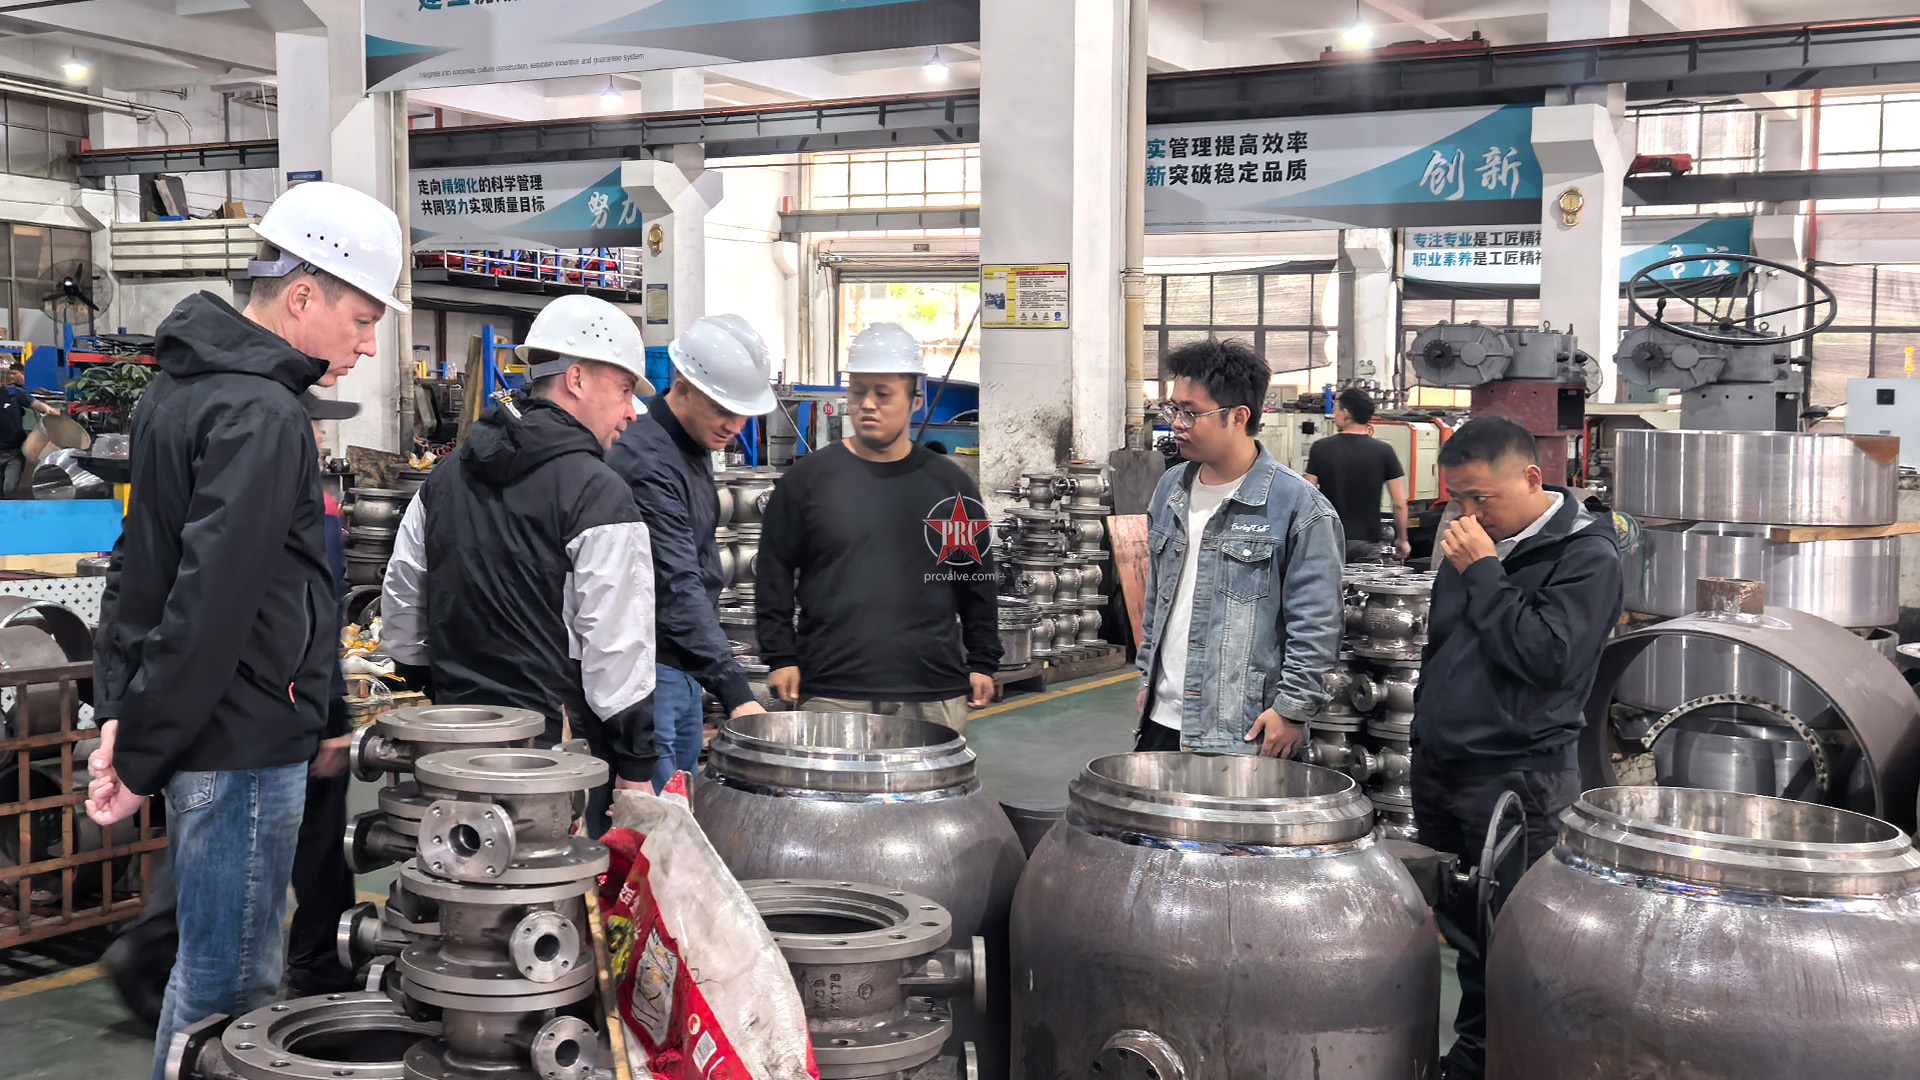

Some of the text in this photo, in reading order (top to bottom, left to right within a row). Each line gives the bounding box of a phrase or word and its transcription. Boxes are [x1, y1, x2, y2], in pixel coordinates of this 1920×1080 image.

[581, 56, 591, 64] and
[623, 53, 645, 62] system
[1146, 130, 1308, 160] 实管理提高效率
[417, 174, 544, 195] 走向精细化的科学管理
[1145, 158, 1308, 187] 新突破稳定品质
[1419, 146, 1523, 201] 创新
[421, 195, 545, 216] 共同努力实现质量目标
